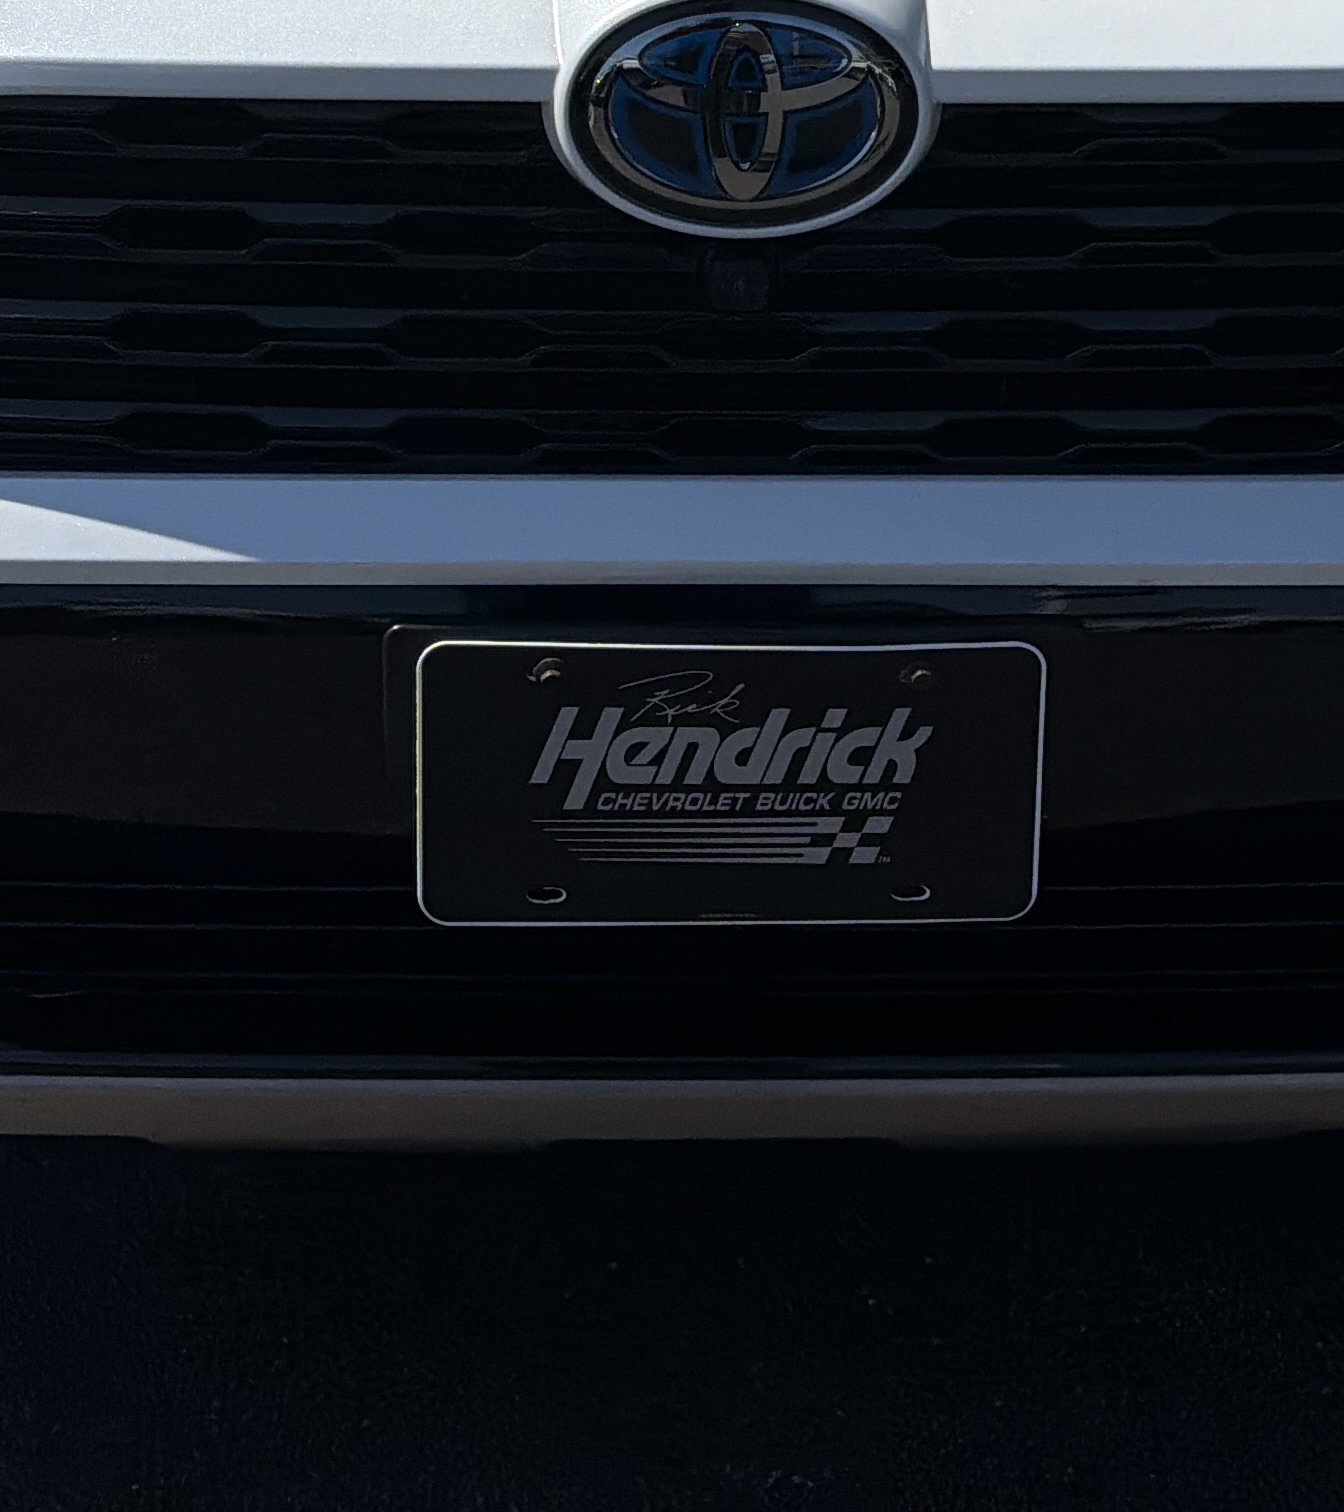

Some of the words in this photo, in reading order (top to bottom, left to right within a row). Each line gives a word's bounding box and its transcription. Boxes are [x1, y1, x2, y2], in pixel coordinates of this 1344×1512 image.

[618, 670, 746, 724] Rick
[529, 706, 934, 810] Hendrick
[597, 792, 751, 812] CHEVROLET
[755, 792, 833, 812] BUICK
[842, 792, 903, 811] GMC
